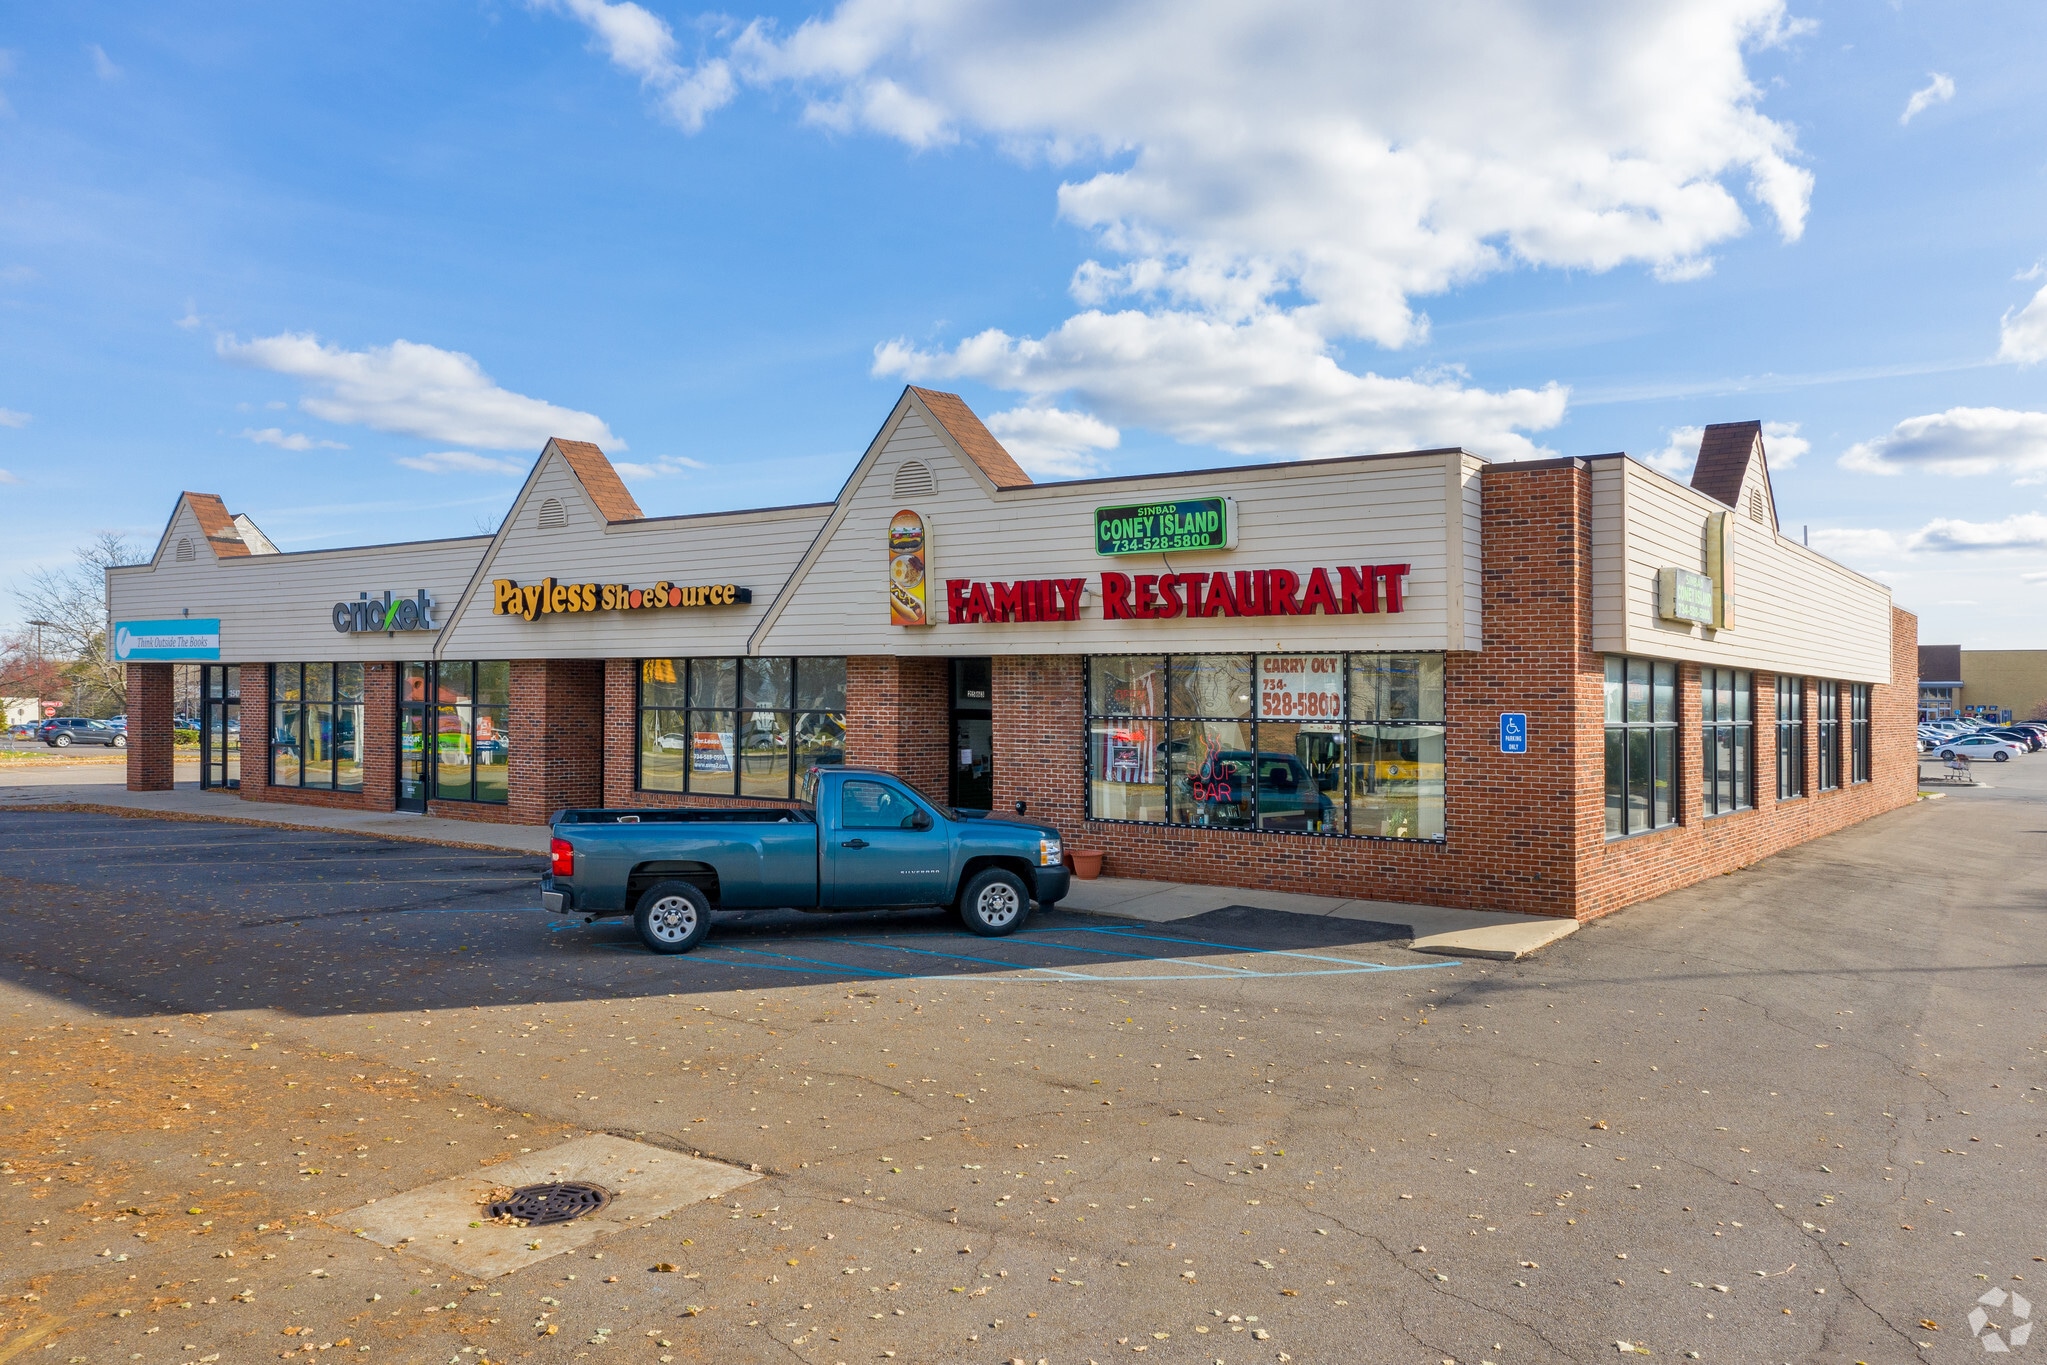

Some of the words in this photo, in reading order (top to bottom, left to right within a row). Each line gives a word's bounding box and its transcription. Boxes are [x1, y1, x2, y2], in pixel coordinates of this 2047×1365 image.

[1137, 505, 1176, 517] SINBAD
[1100, 516, 1154, 541] CONEY
[1160, 511, 1219, 536] ISLAND
[1112, 533, 1210, 552] 734-528-5800
[492, 577, 599, 622] Payless
[946, 578, 1087, 624] FAMILY
[1100, 564, 1411, 621] RESTAURANT
[332, 588, 434, 633] cricket
[137, 637, 154, 648] Think
[154, 636, 176, 648] Outside
[177, 636, 188, 647] The
[189, 636, 208, 647] Books
[1263, 658, 1307, 673] CARRY
[1311, 657, 1338, 673] OUT
[1262, 679, 1287, 691] 734-
[1262, 692, 1340, 717] 528-5800
[1186, 761, 1237, 781] SOUP
[1193, 781, 1232, 802] BAR
